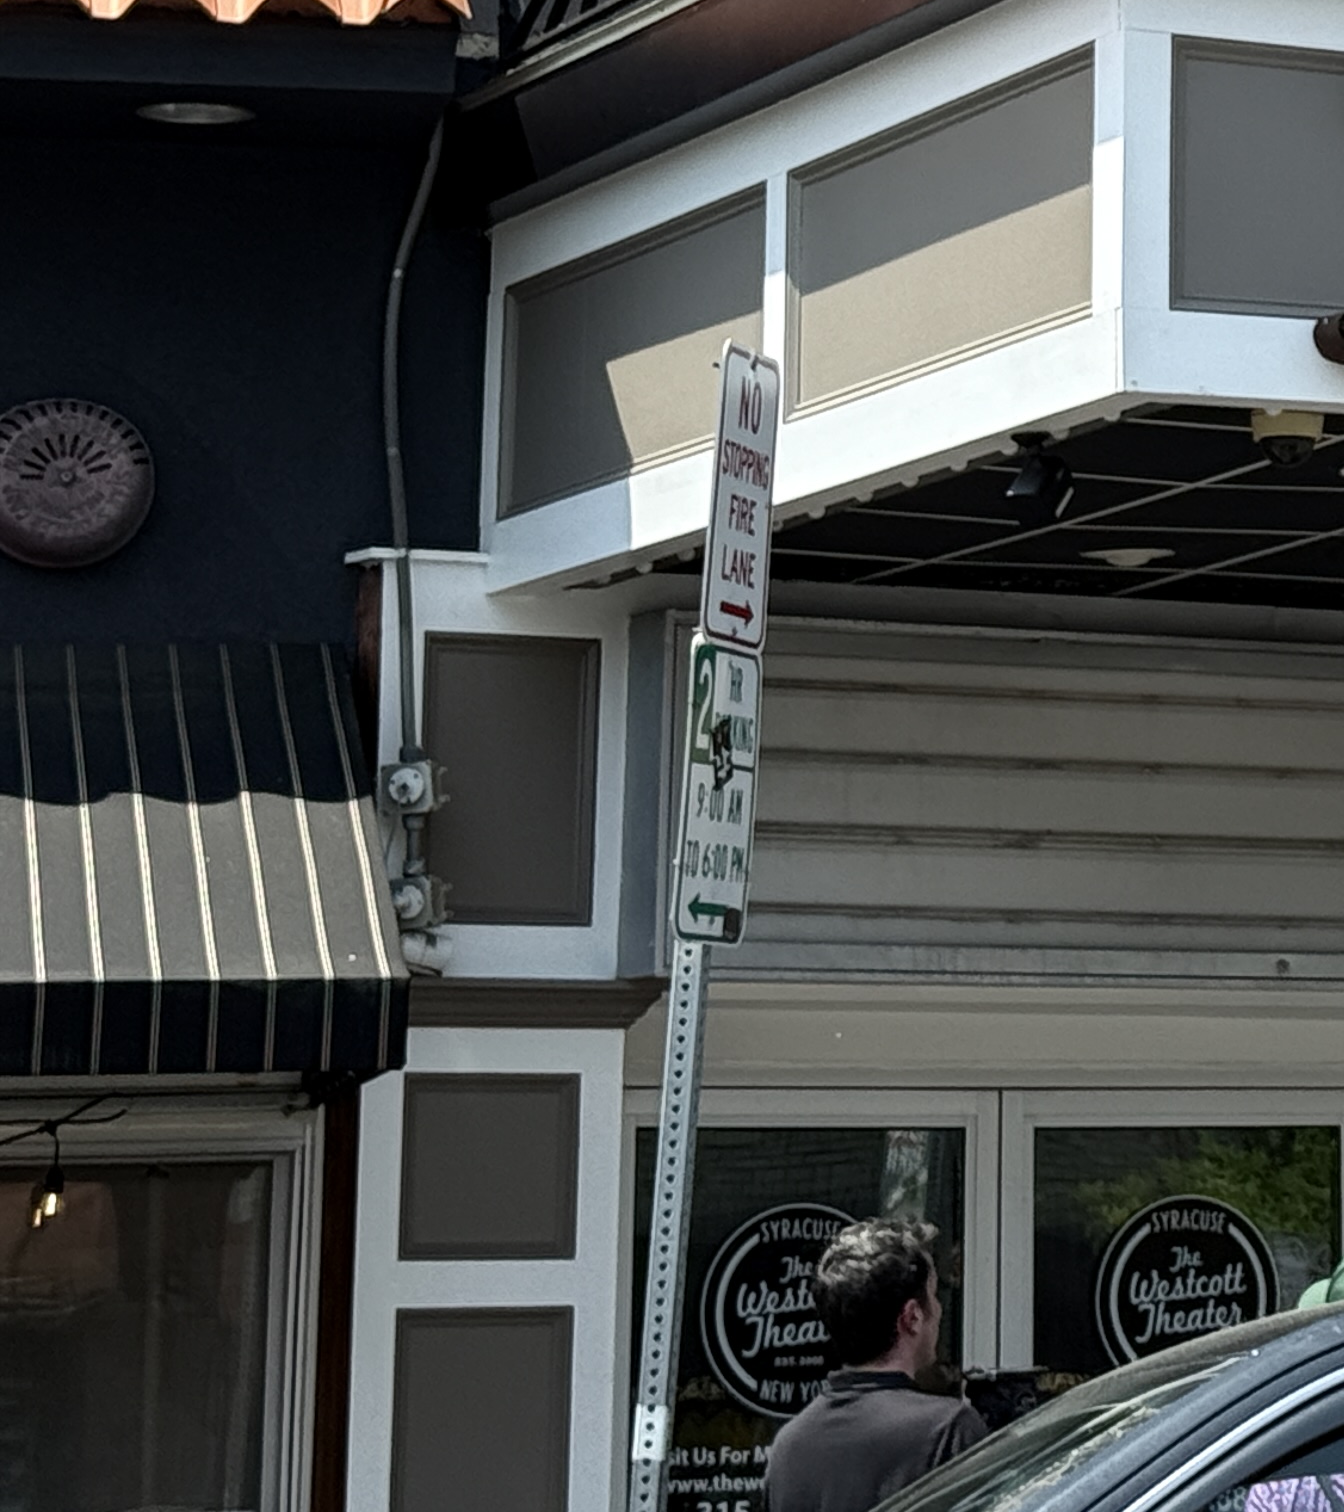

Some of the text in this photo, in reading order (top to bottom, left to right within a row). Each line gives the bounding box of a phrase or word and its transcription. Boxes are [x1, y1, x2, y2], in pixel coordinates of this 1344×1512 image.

[738, 375, 762, 435] NO
[721, 439, 770, 490] STOPPING
[729, 493, 758, 536] FIRE
[721, 543, 756, 589] LANE
[695, 658, 713, 749] 2
[695, 782, 744, 824] 9:00 AM
[685, 840, 745, 883] TO 6:00 PM
[1151, 1208, 1227, 1234] SYRACUSE
[778, 1255, 814, 1284] The
[1169, 1245, 1203, 1273] The
[1129, 1262, 1247, 1305] Westcott
[1135, 1298, 1243, 1343] Theater
[759, 1378, 795, 1404] NEW
[693, 1446, 716, 1467] Us
[720, 1445, 751, 1466] For
